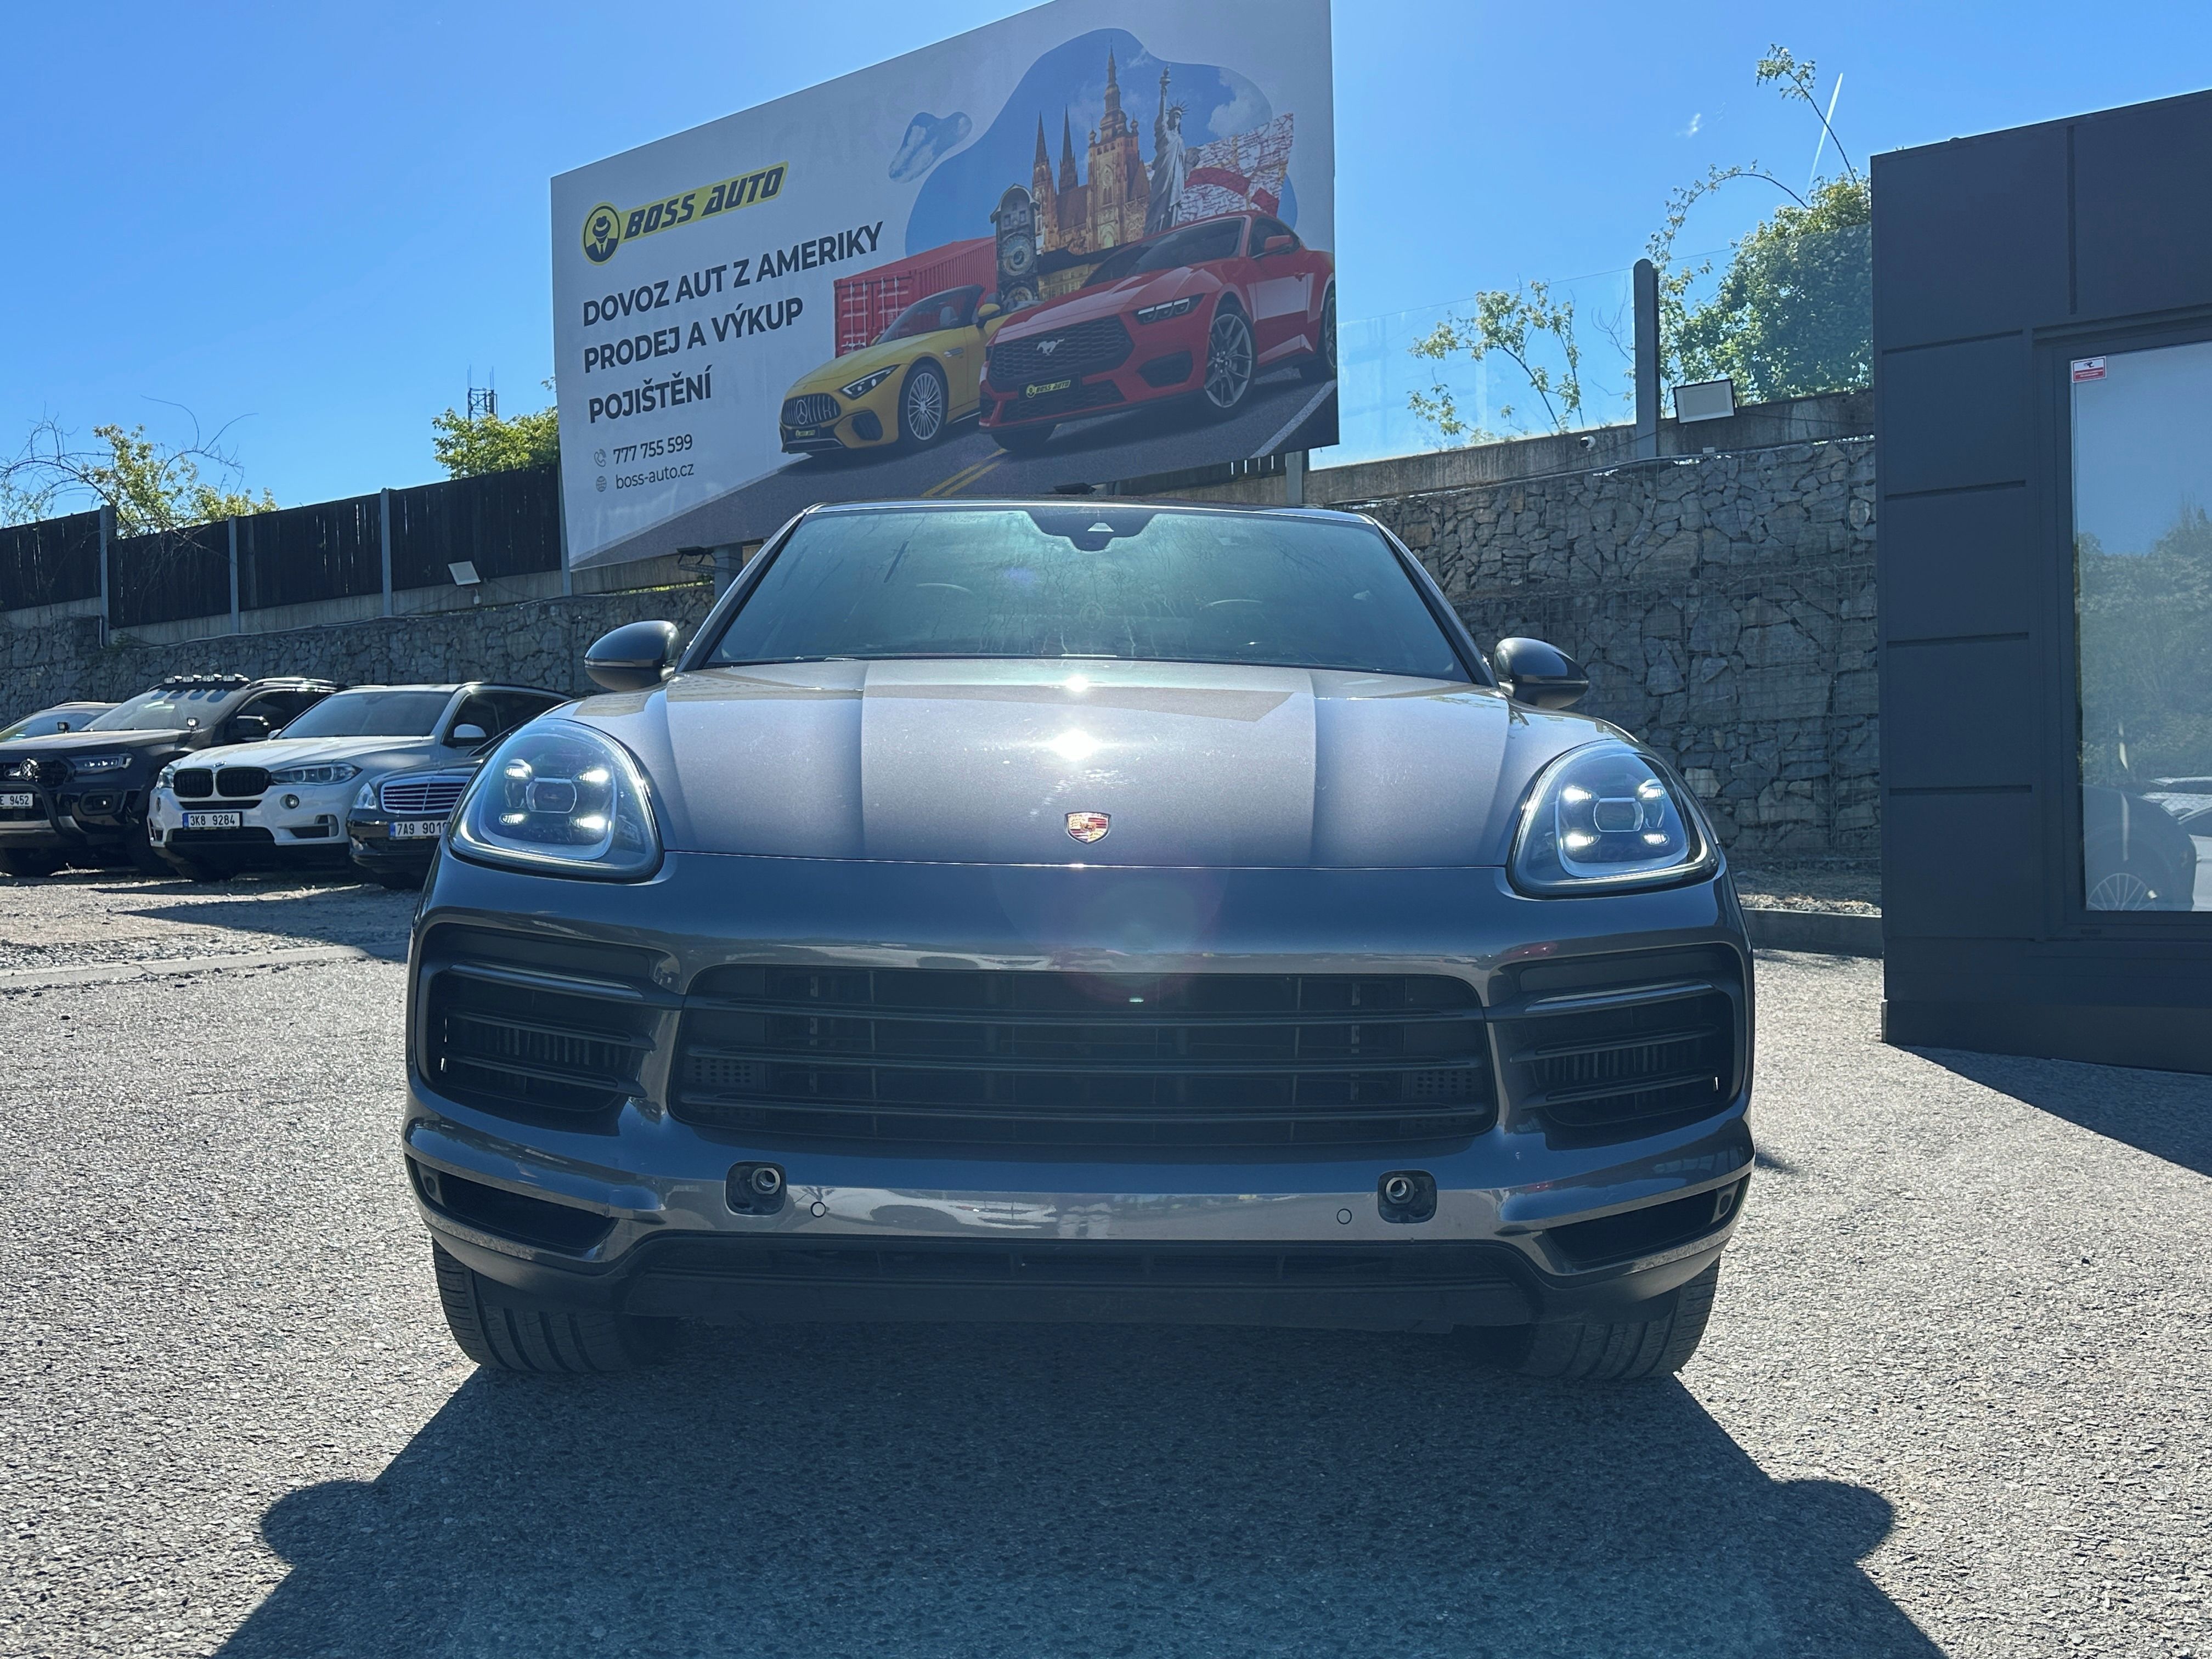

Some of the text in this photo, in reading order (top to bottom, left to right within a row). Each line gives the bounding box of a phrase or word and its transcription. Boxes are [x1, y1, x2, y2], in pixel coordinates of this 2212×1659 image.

[624, 166, 784, 239] BOSS AUTO
[584, 221, 883, 326] DOVOZ AUT Z AMERIKY
[584, 297, 803, 373] PRODEJ A VÝKUP
[589, 364, 713, 424] POJIŠTĚNÍ
[613, 434, 693, 464] 777 755 599
[616, 464, 694, 489] boss-auto.cz
[10, 795, 29, 805] 9452
[190, 815, 235, 826] 3K8 9284
[397, 823, 414, 835] 7A9
